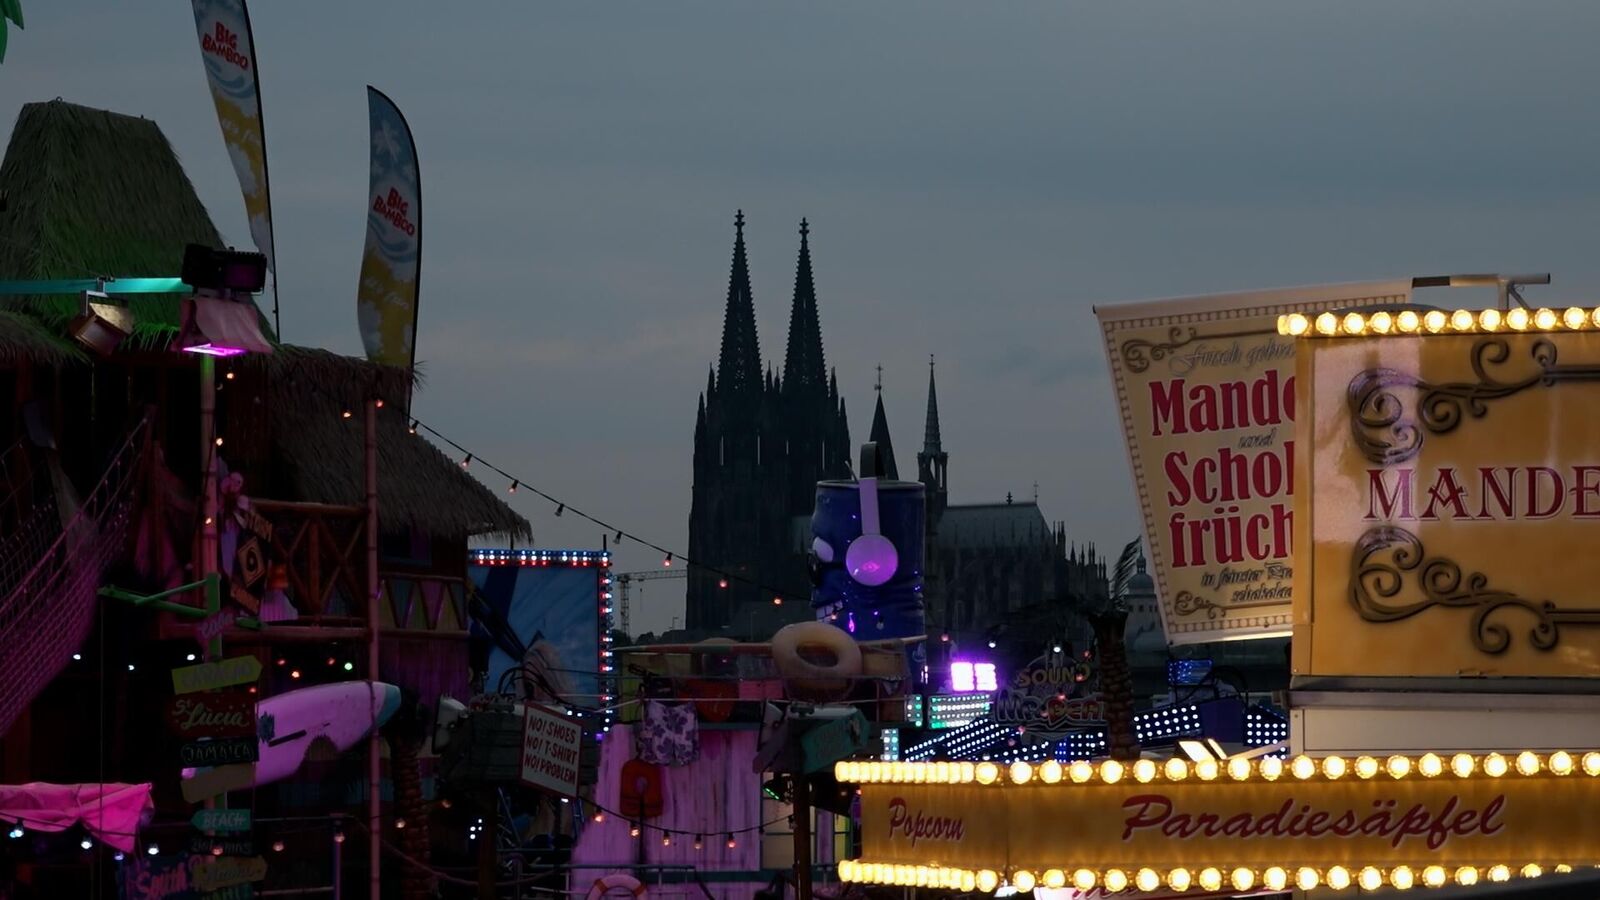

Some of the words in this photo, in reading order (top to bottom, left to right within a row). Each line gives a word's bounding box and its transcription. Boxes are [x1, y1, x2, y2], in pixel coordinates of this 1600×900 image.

[215, 21, 237, 49] BIG
[202, 32, 248, 71] BAMBOO
[373, 195, 415, 236] BAMBOO
[387, 186, 409, 217] BIG
[1362, 466, 1600, 521] MANDE
[181, 702, 251, 731] Lucia
[528, 716, 546, 735] NO!
[547, 721, 576, 744] SHOES
[181, 743, 254, 762] JAMAICA
[526, 735, 543, 753] NO!
[545, 740, 577, 765] T-SHIRT
[540, 758, 576, 785] PROBLEM
[202, 812, 247, 830] BEACH
[888, 797, 963, 849] Popcorn
[1121, 793, 1506, 850] Paradiesäpfel
